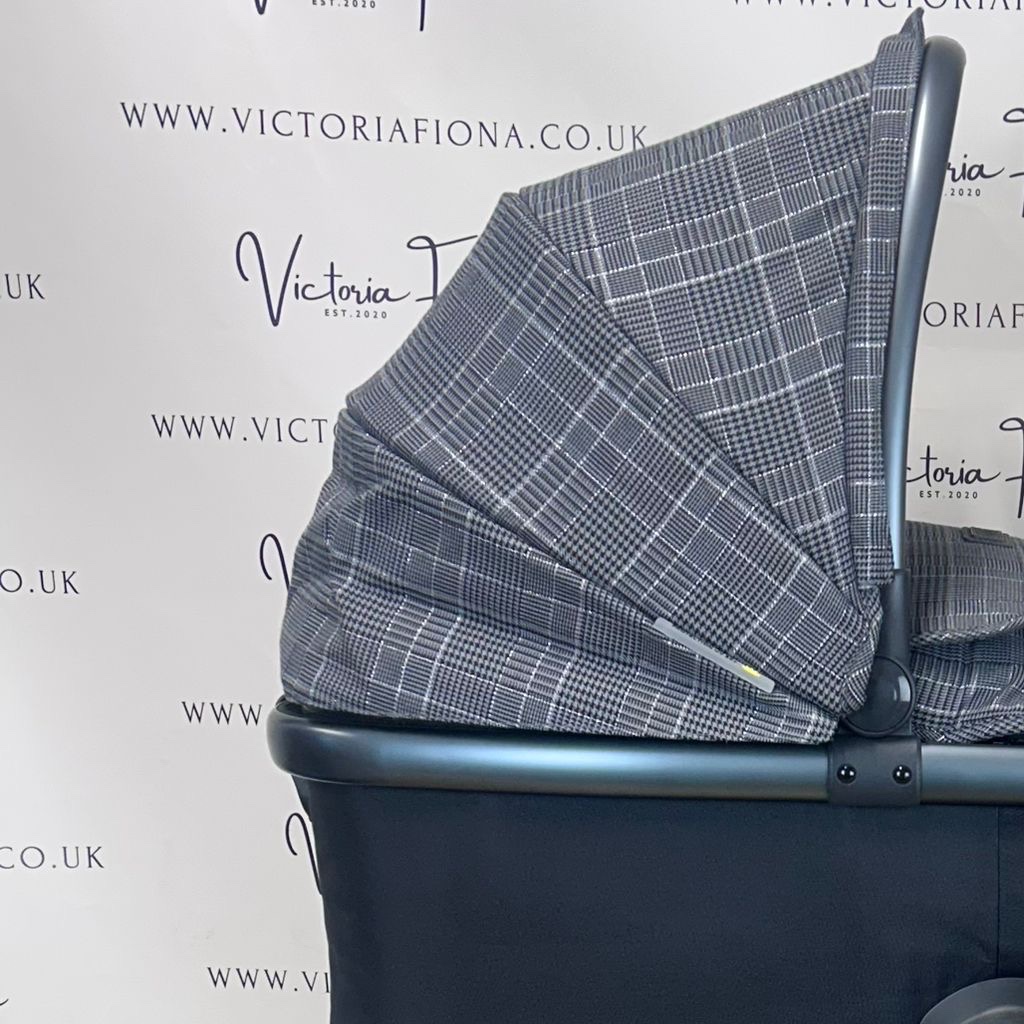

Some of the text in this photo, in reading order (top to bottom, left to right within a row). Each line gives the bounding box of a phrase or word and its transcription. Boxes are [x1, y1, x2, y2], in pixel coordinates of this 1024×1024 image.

[119, 101, 649, 151] WWW.VICTORIAFIONA.CO.UK
[235, 230, 411, 327] Victoria
[324, 308, 388, 319] EST.2020
[150, 414, 338, 443] WWW.VICT
[919, 490, 979, 499] EST.2020
